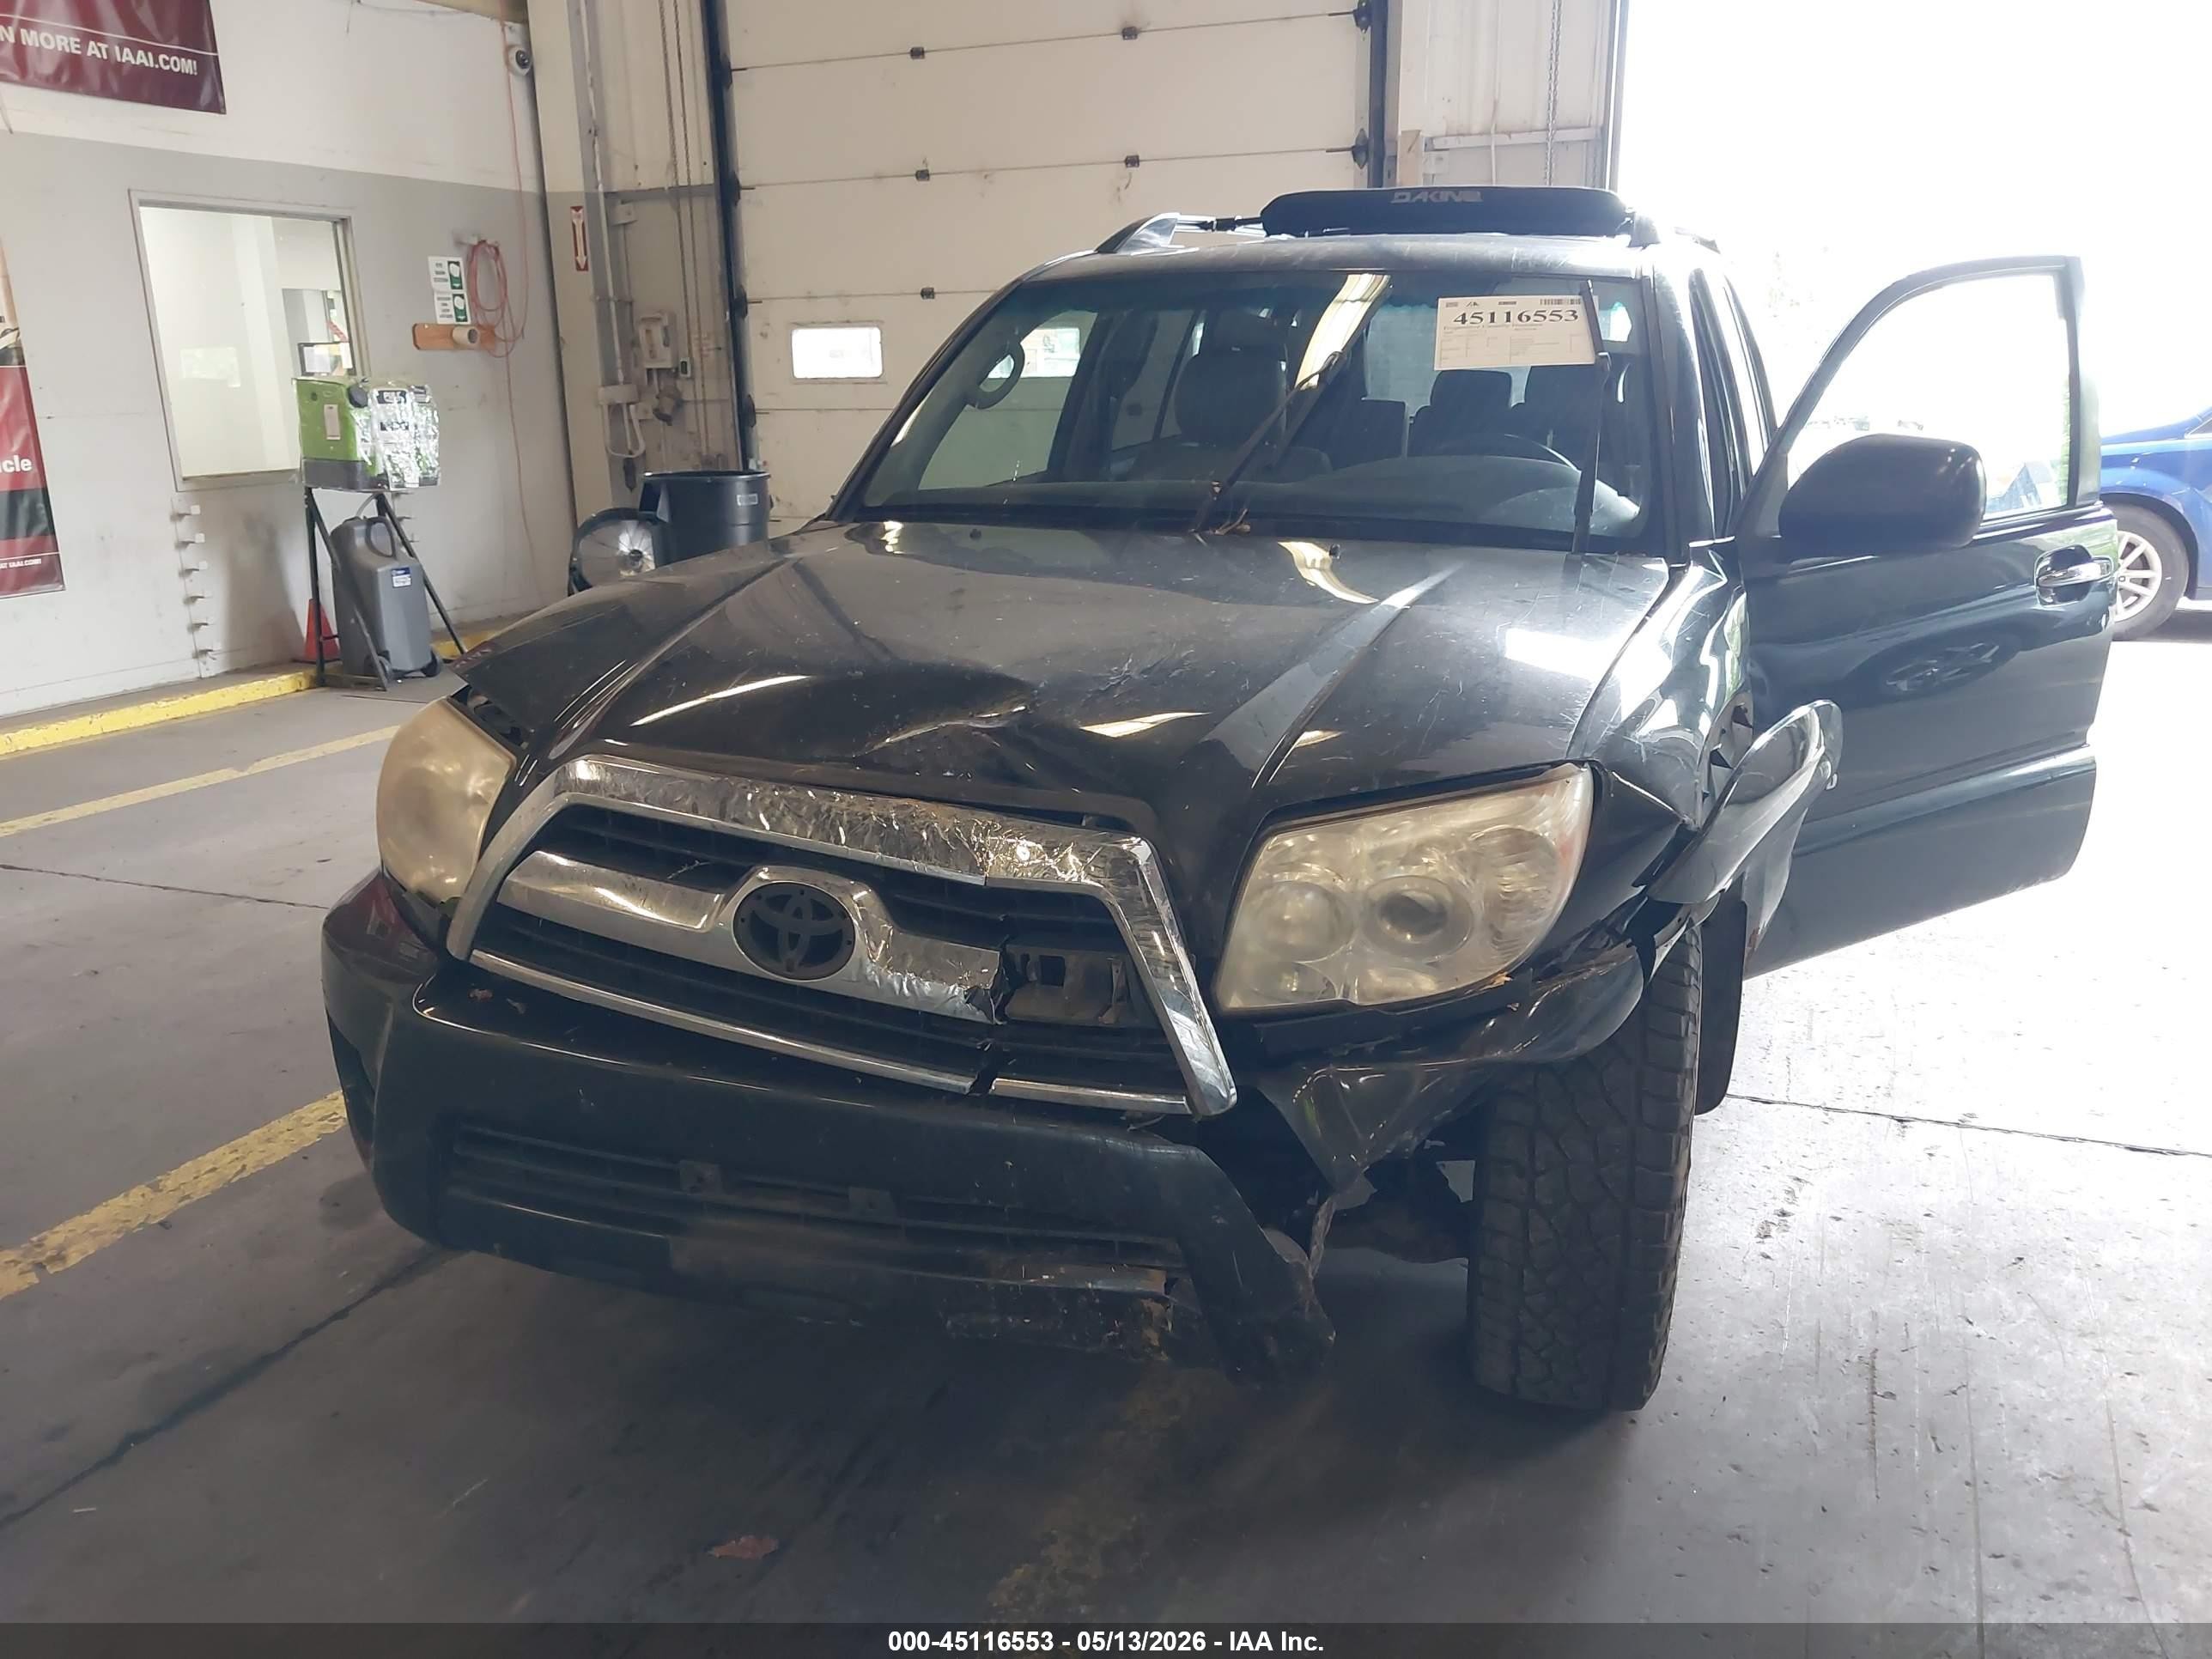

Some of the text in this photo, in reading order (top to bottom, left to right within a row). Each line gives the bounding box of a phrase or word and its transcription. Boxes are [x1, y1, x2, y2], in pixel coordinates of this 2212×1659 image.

[20, 28, 82, 55] MORE
[87, 40, 109, 60] AT
[114, 46, 198, 76] IAAI.COM!
[1453, 309, 1579, 325] 45116553
[0, 455, 33, 472] cle
